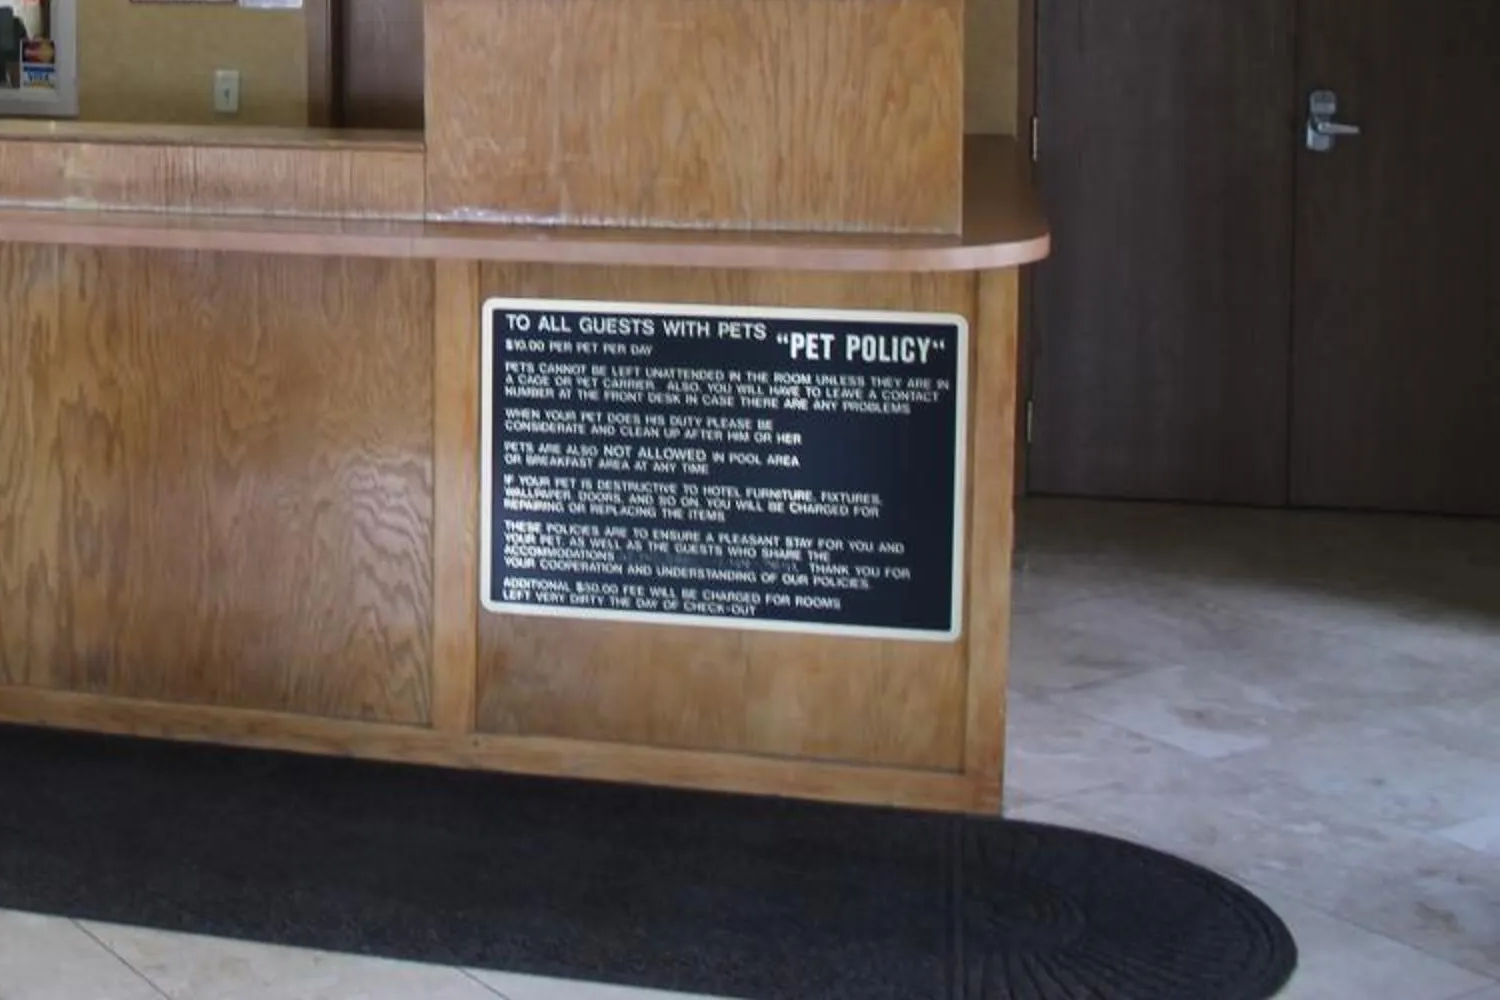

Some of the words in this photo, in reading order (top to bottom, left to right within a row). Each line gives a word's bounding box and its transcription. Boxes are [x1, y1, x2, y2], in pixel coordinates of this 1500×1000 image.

[505, 313, 530, 331] TO
[537, 314, 572, 332] ALL
[578, 316, 654, 336] GUESTS
[661, 319, 710, 338] WITH
[717, 321, 767, 340] PETS
